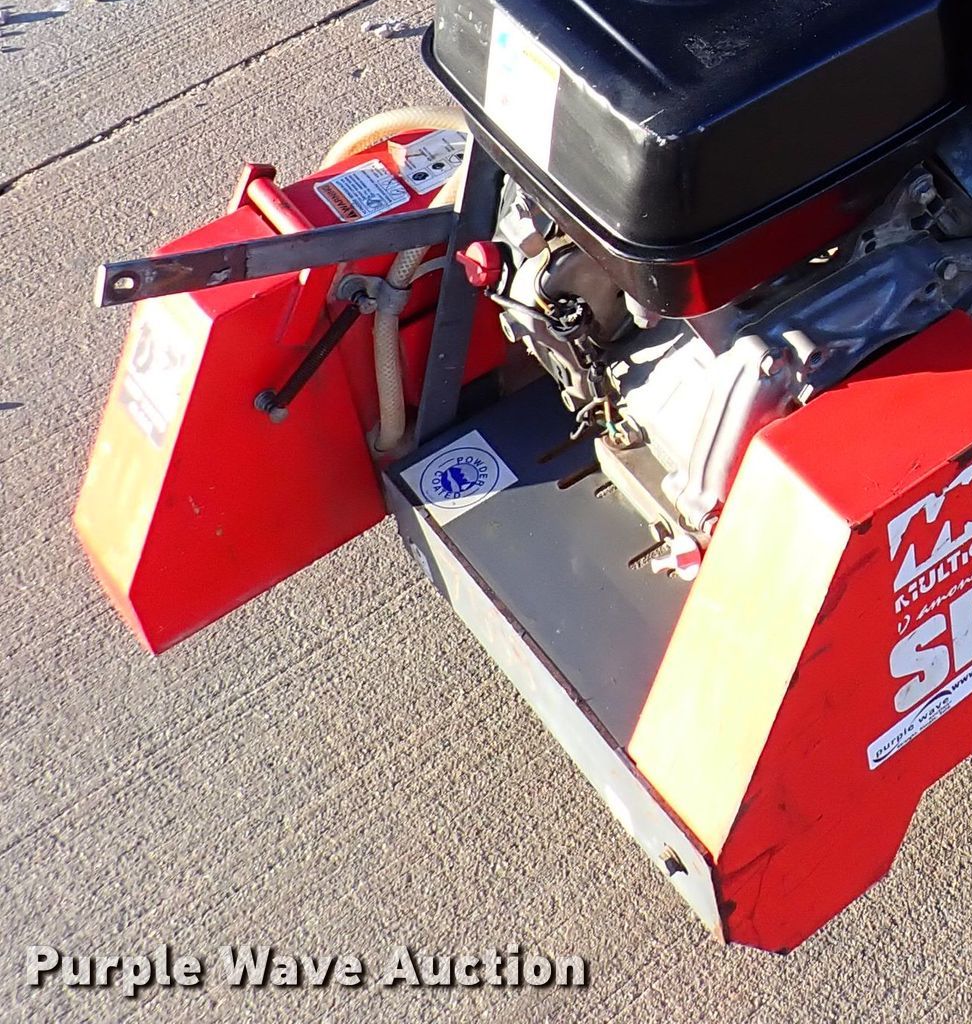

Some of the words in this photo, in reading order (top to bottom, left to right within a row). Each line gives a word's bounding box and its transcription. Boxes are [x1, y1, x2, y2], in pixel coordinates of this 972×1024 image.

[431, 470, 461, 499] COATED
[456, 455, 488, 487] POWDER
[875, 723, 915, 758] purple
[918, 696, 950, 723] wave
